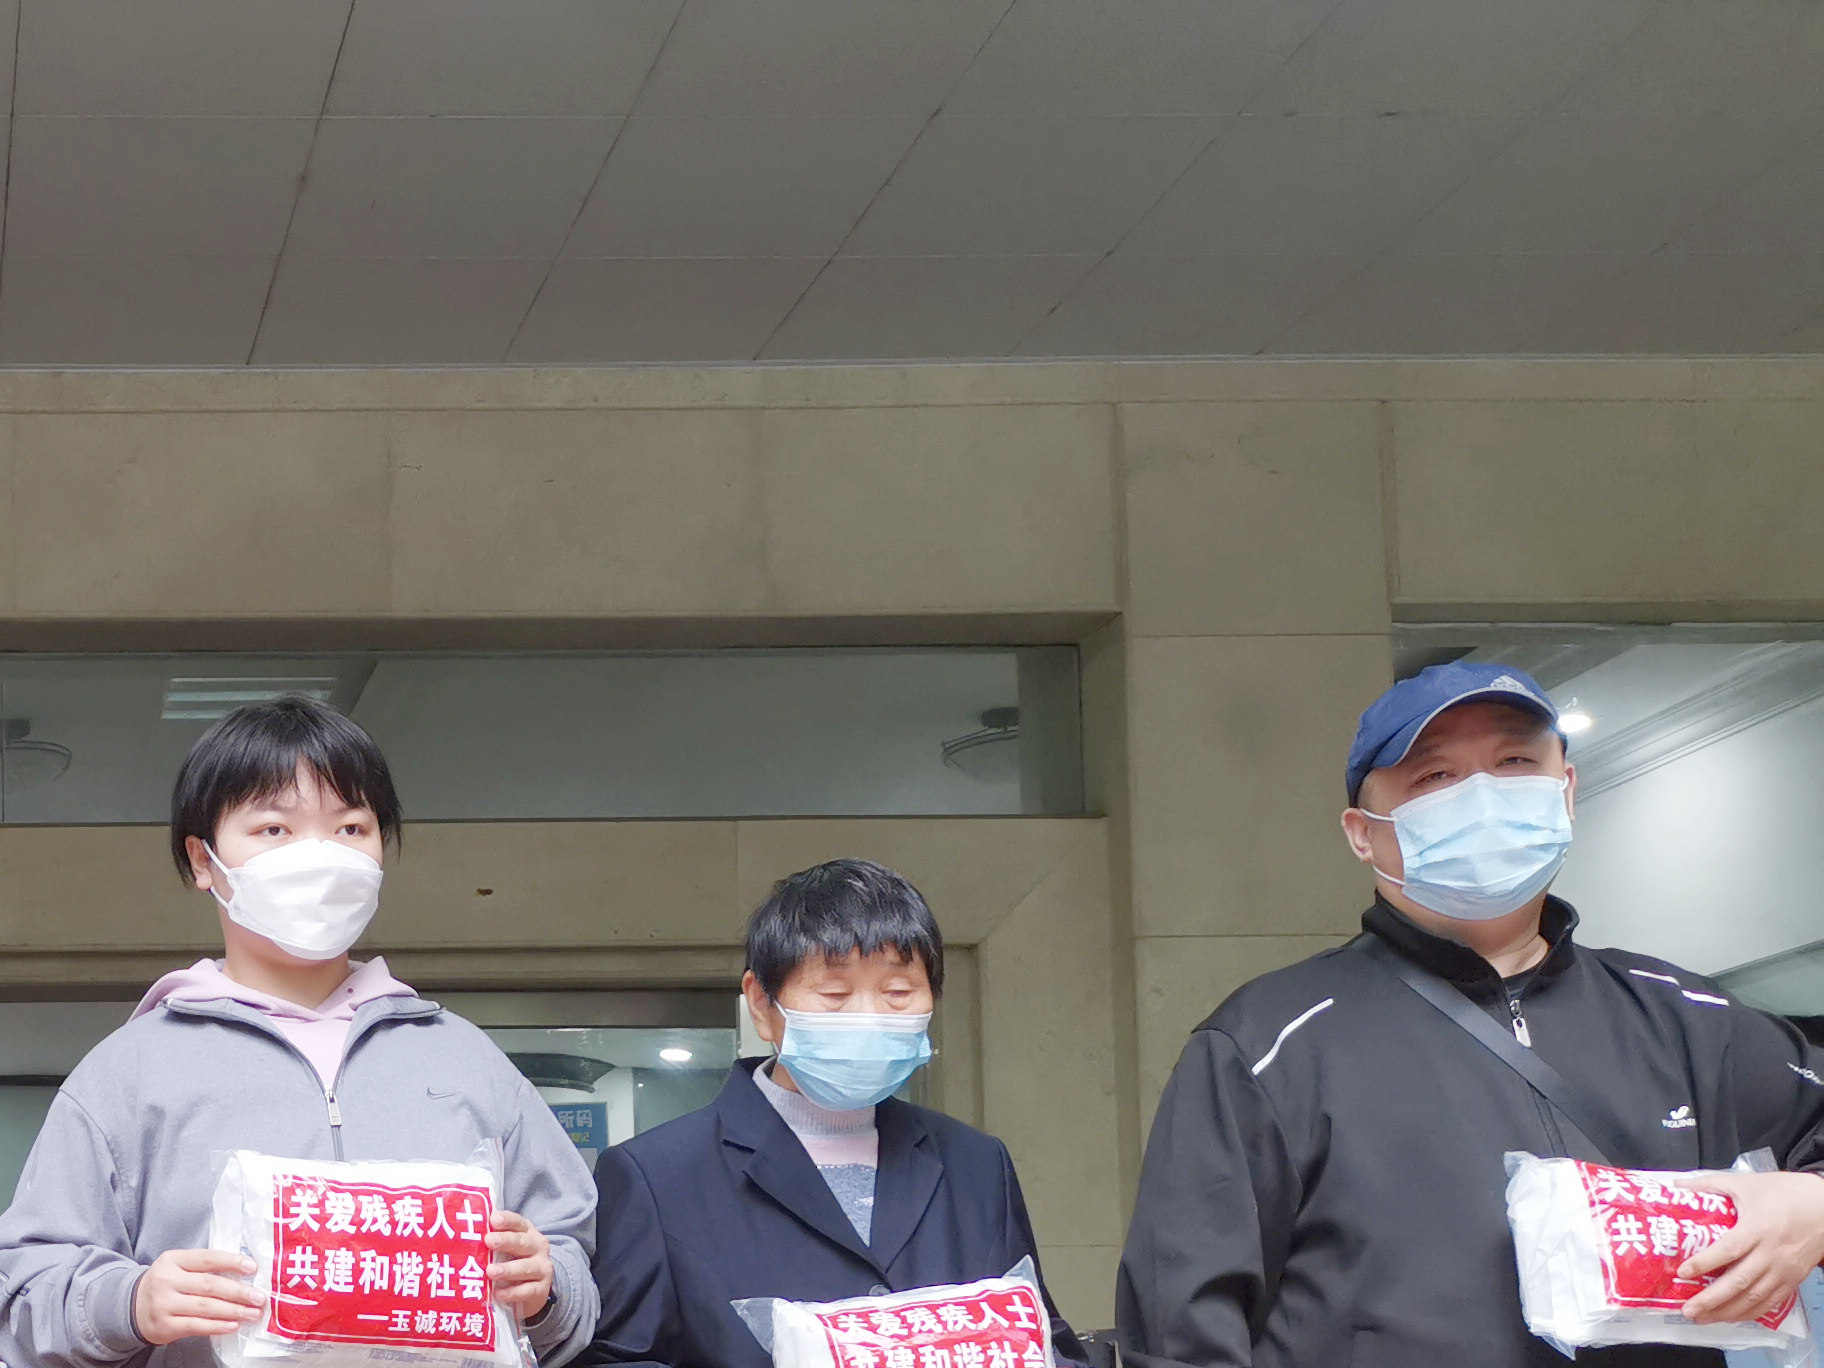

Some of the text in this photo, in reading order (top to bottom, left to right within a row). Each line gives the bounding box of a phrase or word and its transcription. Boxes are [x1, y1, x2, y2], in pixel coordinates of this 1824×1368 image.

[287, 1189, 484, 1241] 关爱残疾人士
[286, 1246, 486, 1301] 共建和谐社会
[838, 1295, 1038, 1337] 关爱残疾人士
